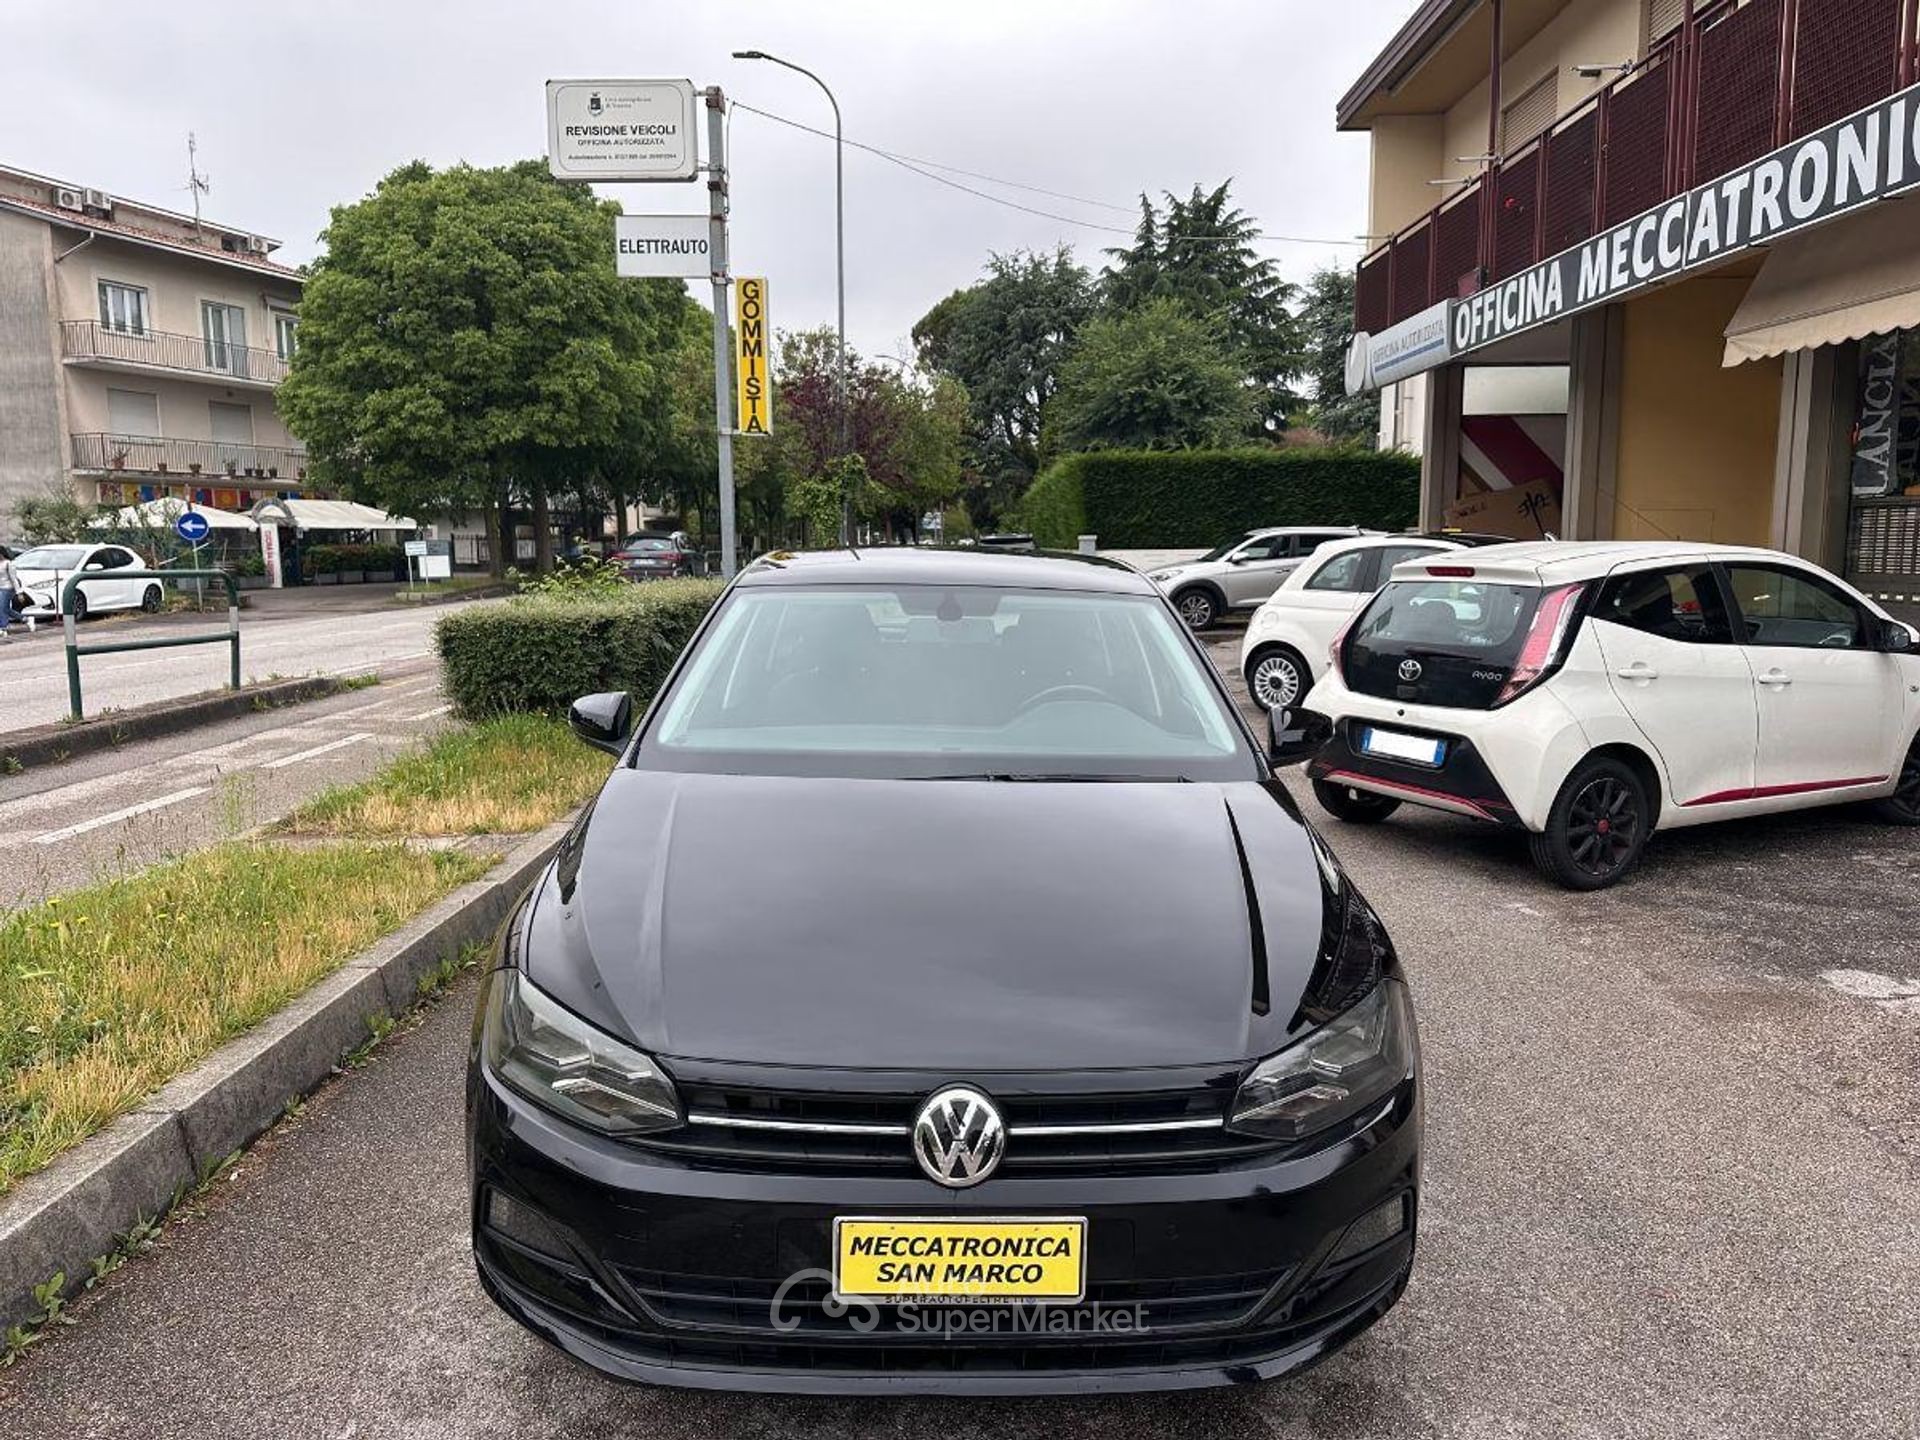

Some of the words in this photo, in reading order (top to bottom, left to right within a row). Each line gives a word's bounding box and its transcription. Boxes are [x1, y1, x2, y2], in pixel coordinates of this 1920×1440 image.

[566, 126, 627, 136] REVISIONE
[630, 125, 676, 135] VEICOLI
[1455, 259, 1563, 349] OFFICINA
[1577, 98, 1920, 303] MECCATRONI
[619, 239, 708, 254] ELETTRAUTO
[742, 280, 763, 433] GOMMISTA
[1852, 329, 1898, 499] LANCIA
[850, 1236, 1071, 1257] MECCATRONICA
[877, 1262, 935, 1283] SAN
[943, 1263, 1043, 1284] MARCO
